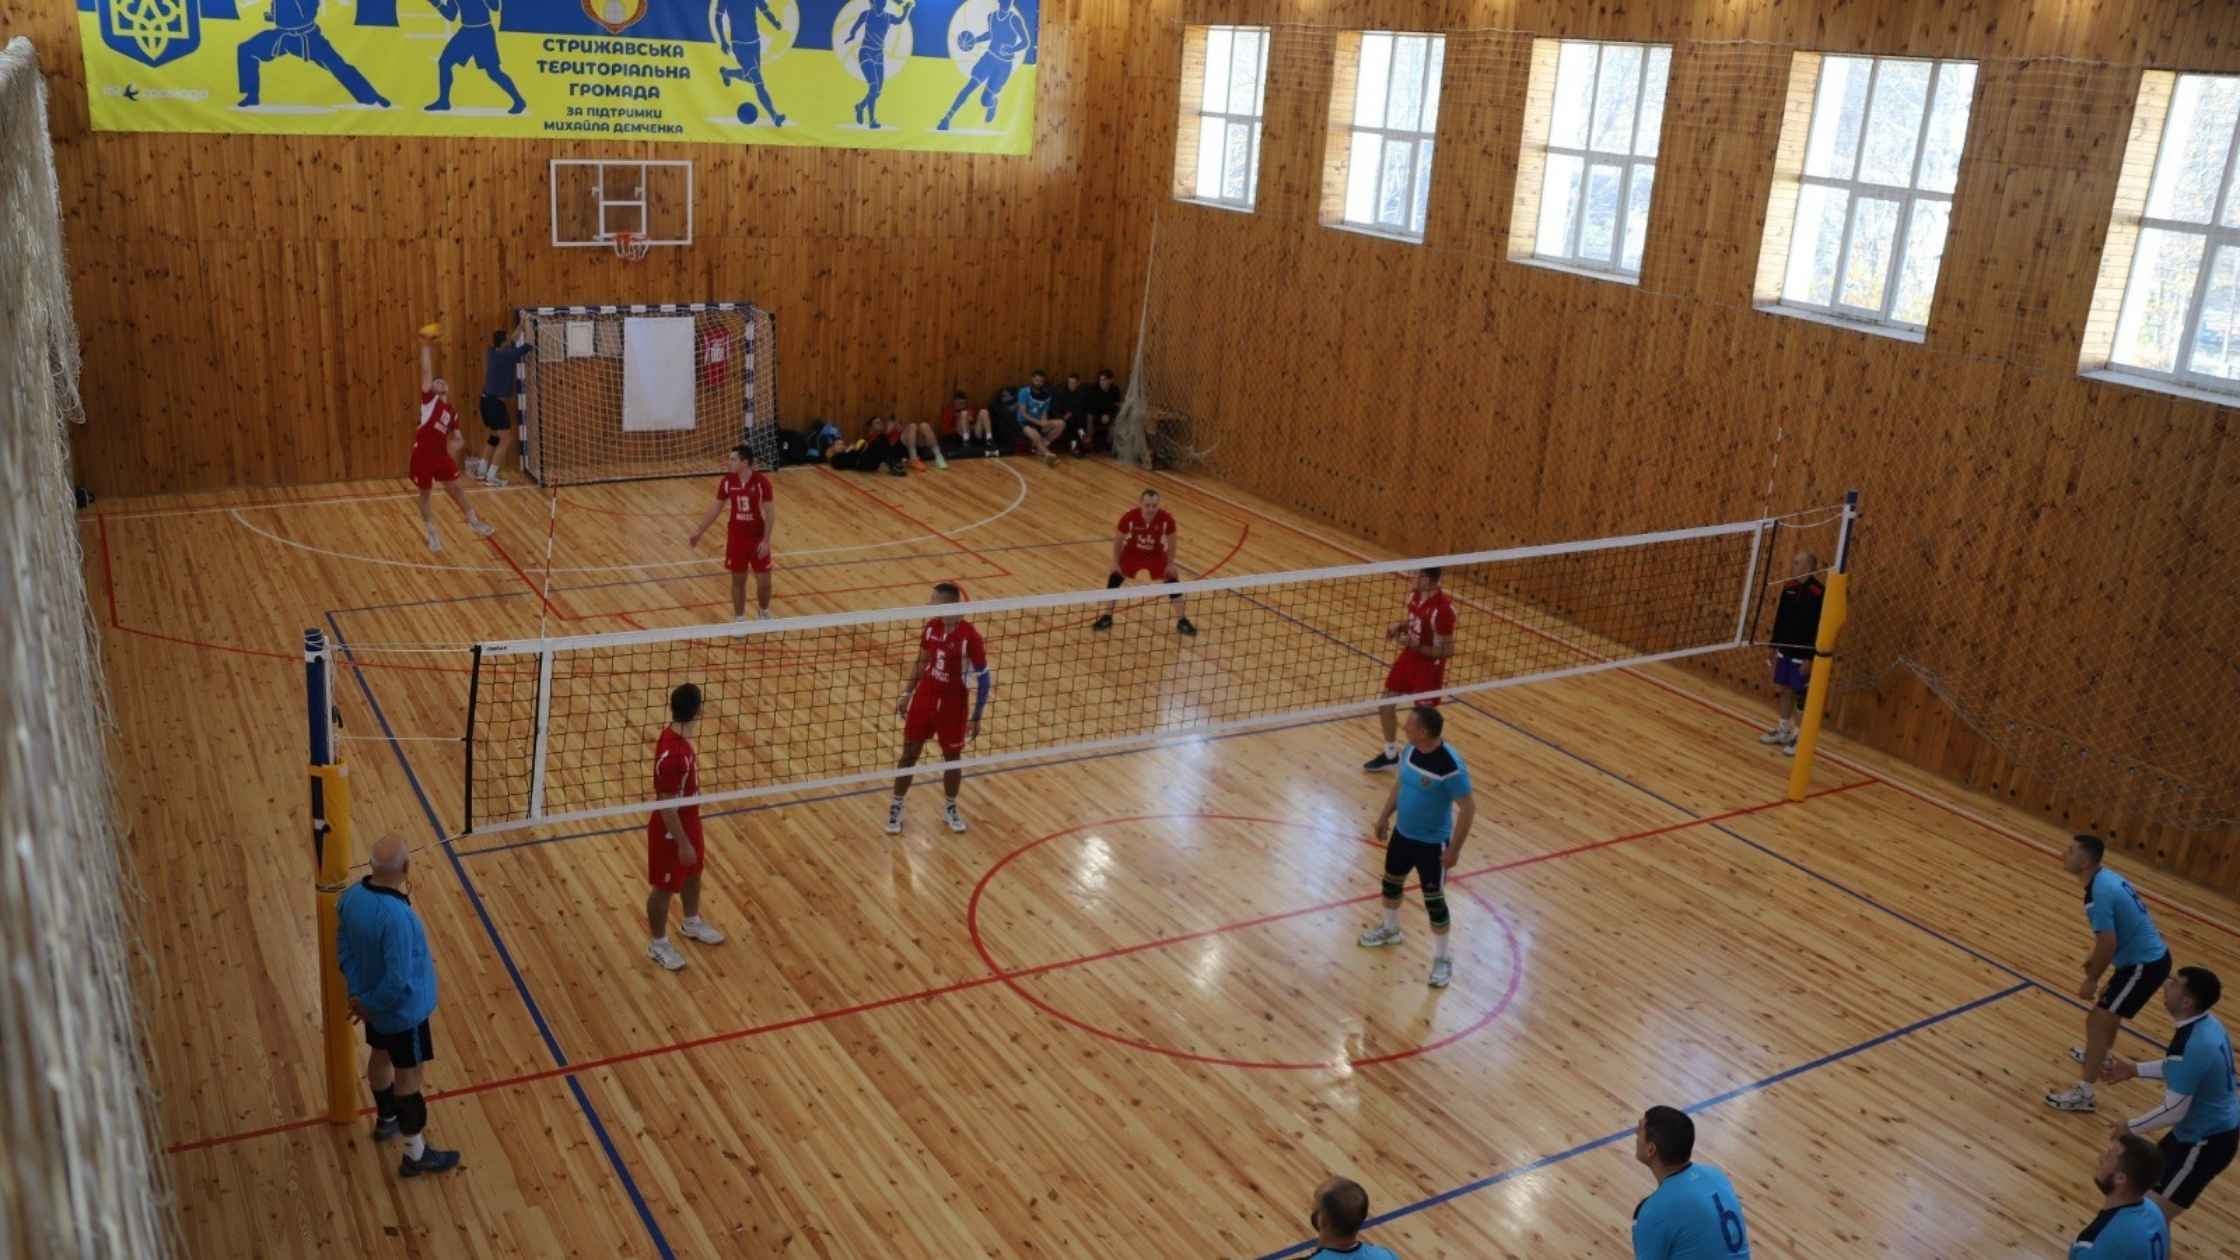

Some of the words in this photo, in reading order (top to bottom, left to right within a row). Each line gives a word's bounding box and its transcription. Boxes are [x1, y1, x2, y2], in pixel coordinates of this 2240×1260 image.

[543, 39, 684, 58] СТРИЖАВСЬКА
[537, 60, 690, 79] ТЕРИТОРІАЛЬНА
[569, 83, 660, 100] ГРОМАДА
[567, 106, 583, 116] ЗА
[587, 107, 662, 118] ПІДТРИМКИ
[544, 121, 610, 131] МИХАЙЛА
[613, 122, 683, 133] ДЕМЧЕНКА
